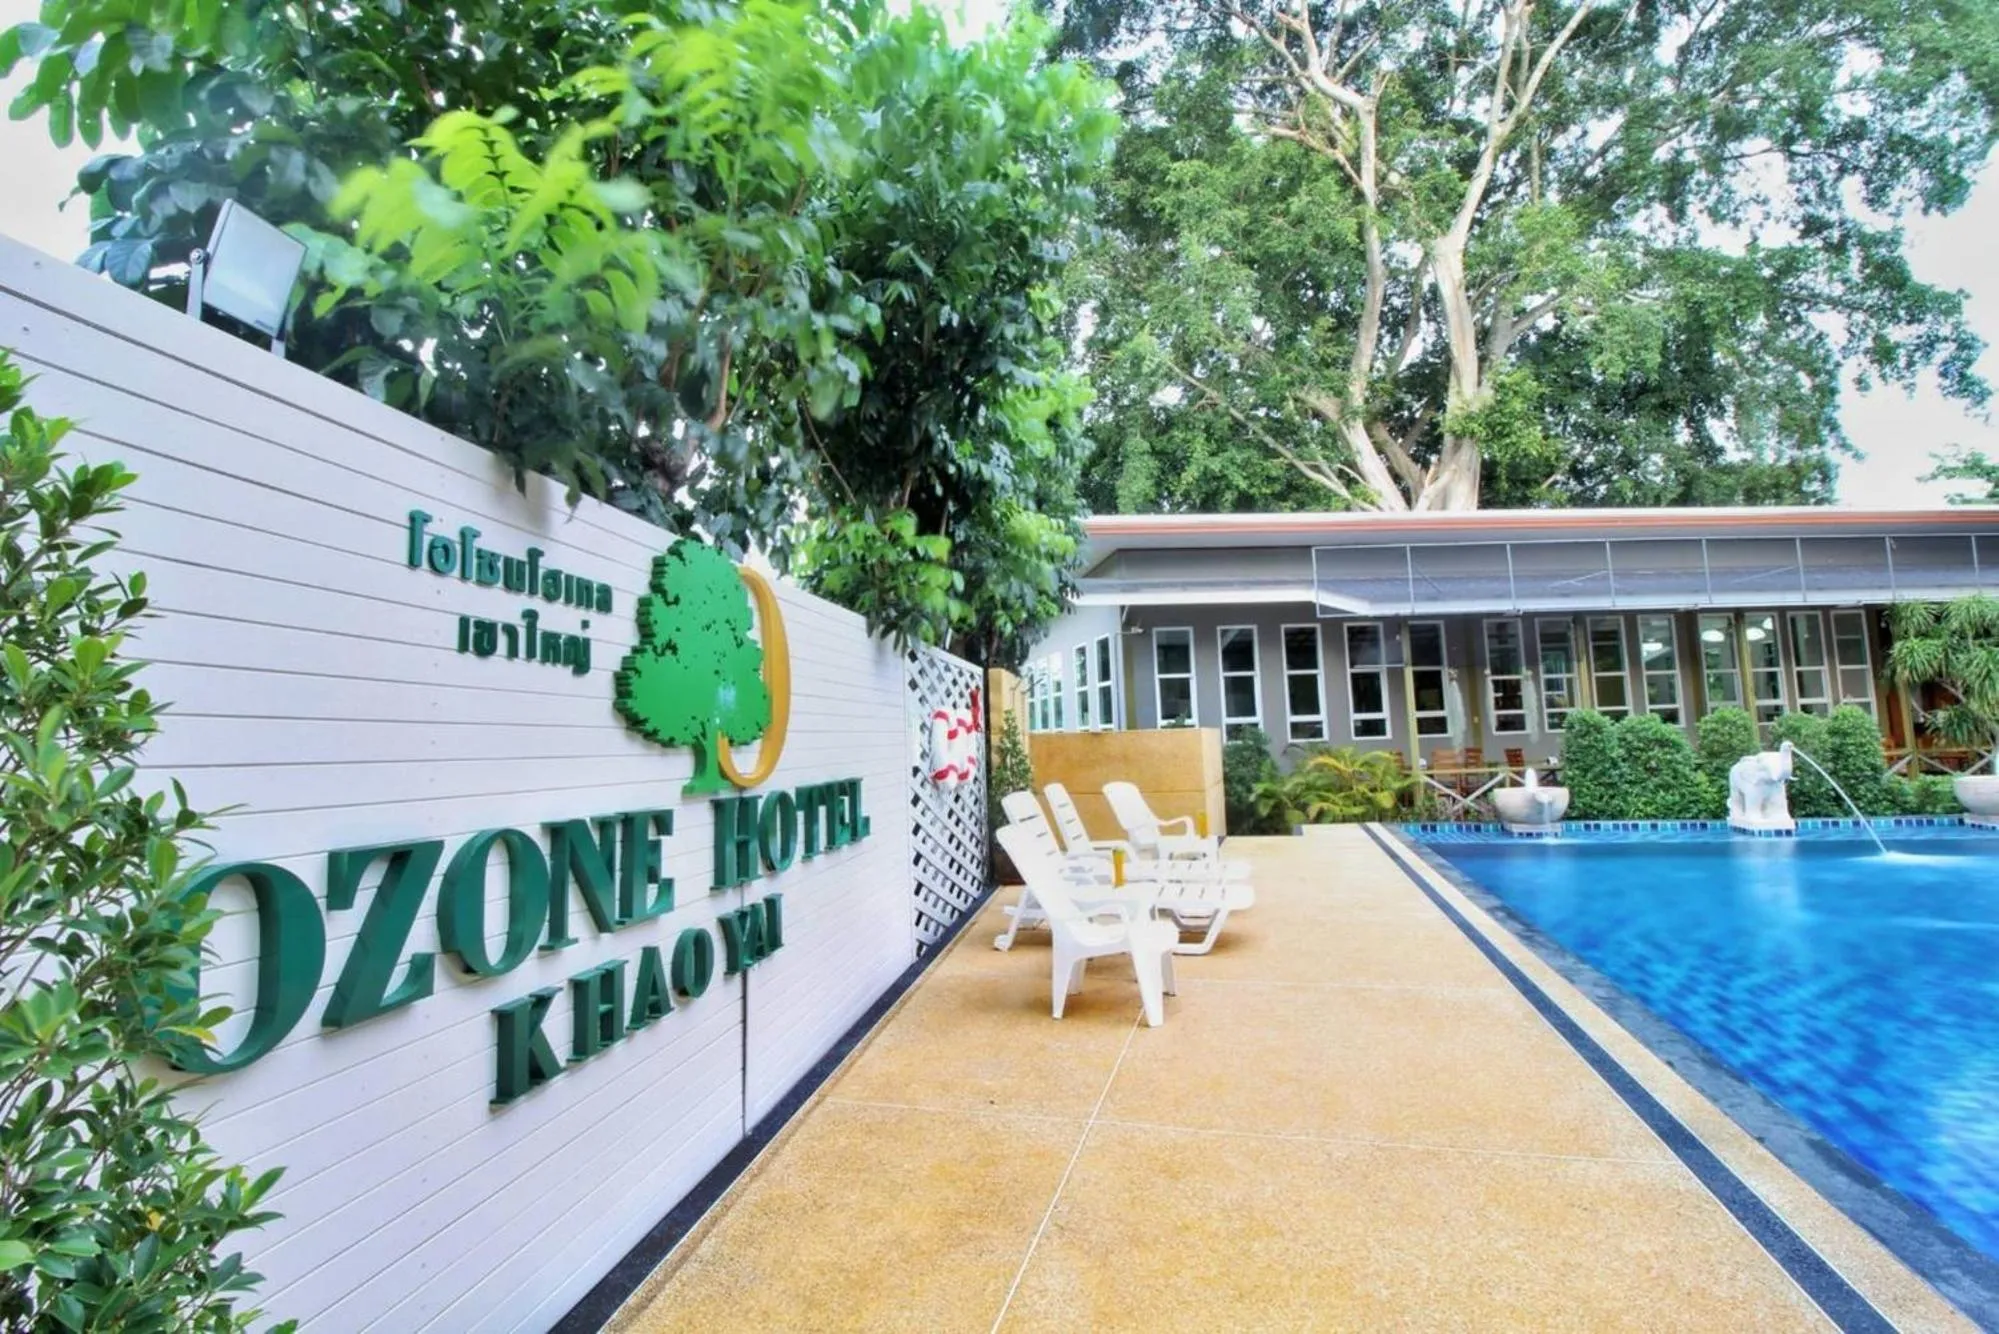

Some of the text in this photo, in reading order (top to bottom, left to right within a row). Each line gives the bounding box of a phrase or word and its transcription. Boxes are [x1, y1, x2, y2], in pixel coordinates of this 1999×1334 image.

[409, 509, 613, 613] โอโซนโฮเทล
[457, 608, 591, 676] เขาใหญ่
[146, 777, 871, 1075] OZONE HOTEL
[490, 893, 784, 1108] KHAO YAI
